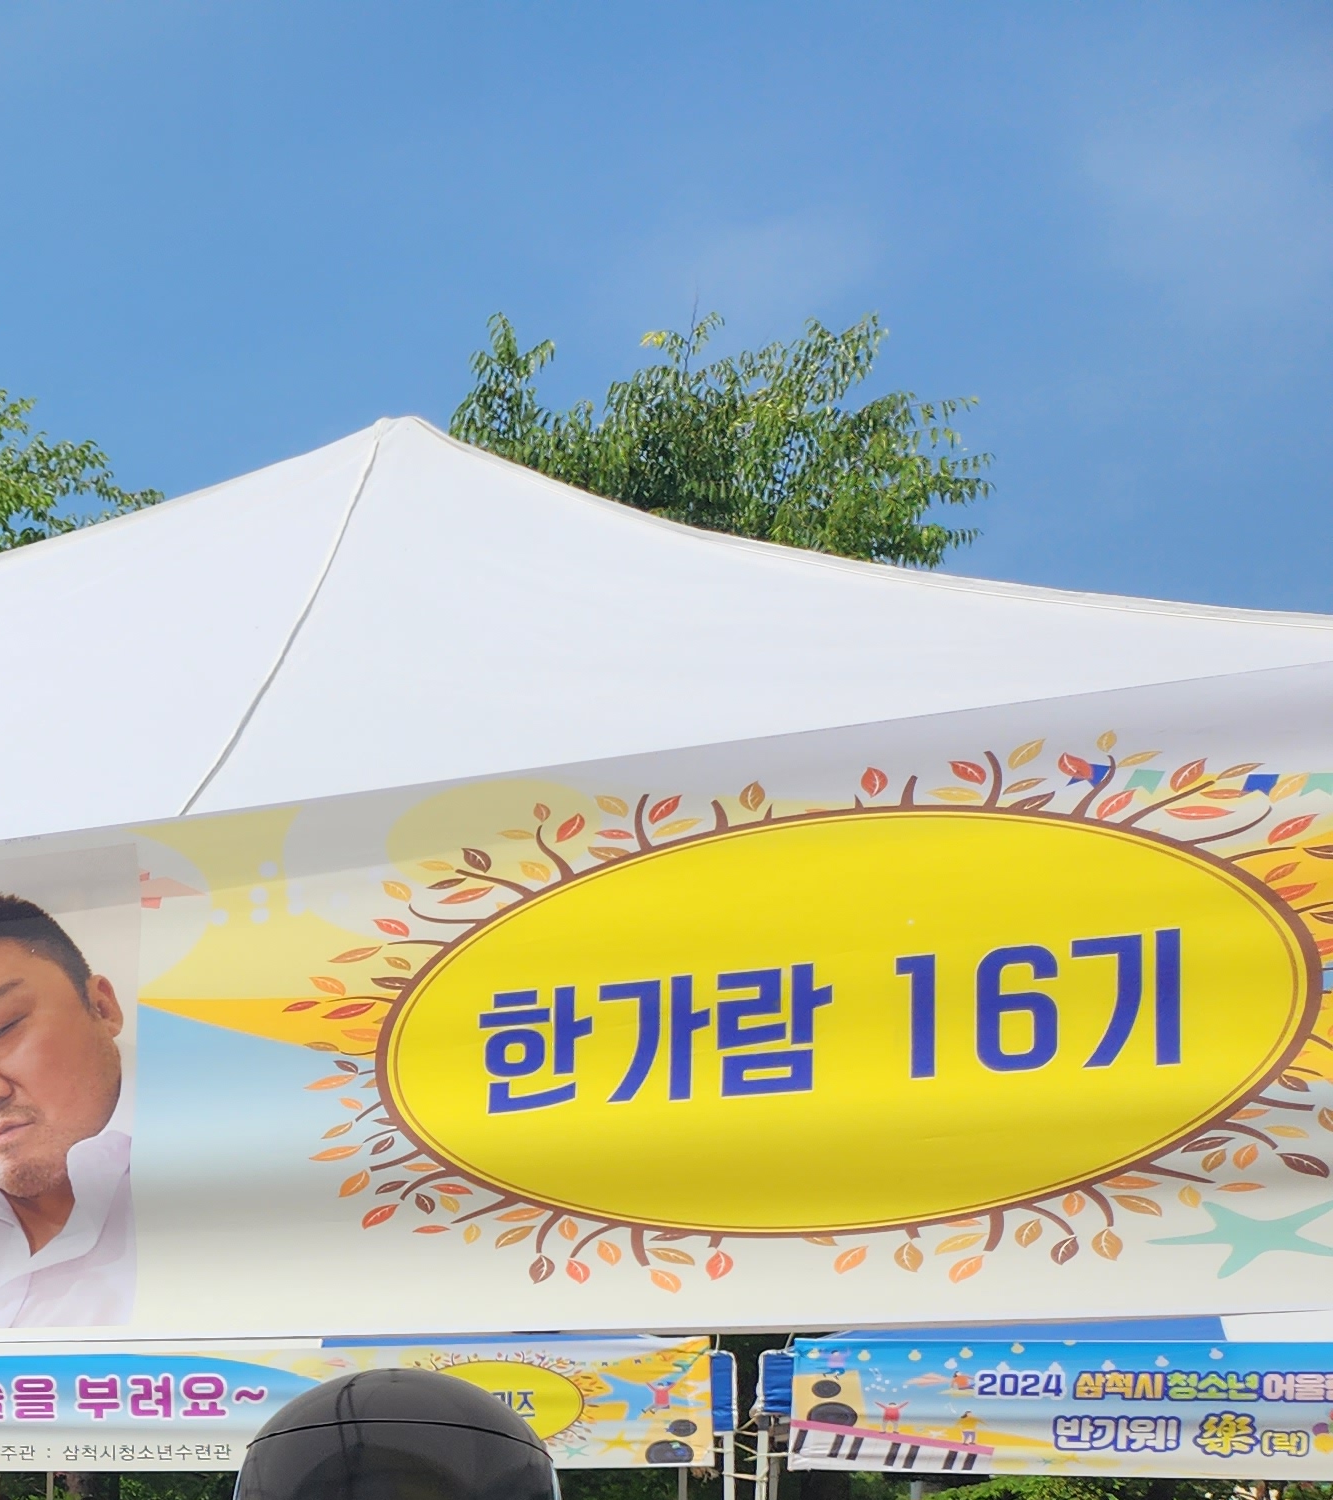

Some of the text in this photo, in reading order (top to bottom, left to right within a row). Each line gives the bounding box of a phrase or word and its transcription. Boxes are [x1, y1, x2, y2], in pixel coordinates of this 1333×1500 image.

[479, 928, 1182, 1115] 한가람 16기
[76, 1374, 266, 1420] 부려요~
[978, 1371, 1333, 1402] 2024 삼척시 청소년 어울
[1055, 1416, 1181, 1451] 반가워!
[0, 1444, 35, 1461] 주관
[62, 1443, 232, 1462] 삼척시청소년수련관
